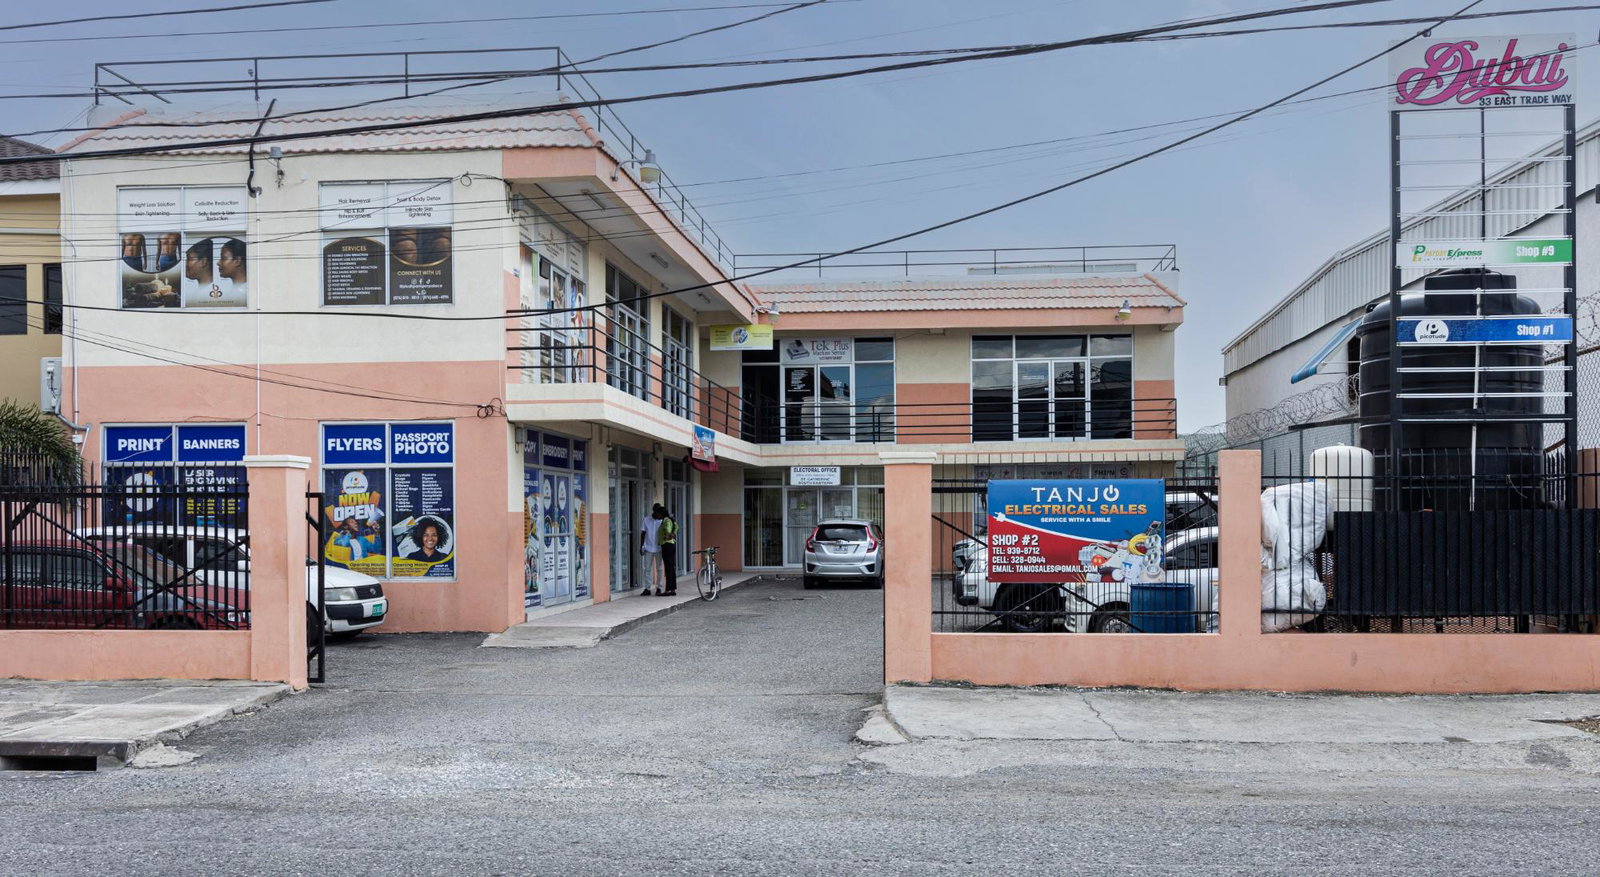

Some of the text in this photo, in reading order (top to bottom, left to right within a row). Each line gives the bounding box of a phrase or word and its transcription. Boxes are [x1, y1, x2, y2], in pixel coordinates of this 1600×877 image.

[1395, 38, 1569, 106] Dubai
[1479, 94, 1572, 106] 33 EAST TRADE WAY
[1447, 248, 1482, 258] Express
[1516, 245, 1554, 258] Shop #9
[1517, 324, 1554, 336] Shop #1
[810, 340, 849, 351] Tek Plus
[394, 432, 450, 442] PASSPORT
[118, 438, 163, 451] PRINT
[183, 439, 240, 450] BANNERS
[327, 438, 383, 451] FLYERS
[394, 441, 450, 454] PHOTO
[338, 492, 370, 506] NOW
[334, 504, 375, 522] OPEN
[1005, 504, 1148, 516] ELECTRICAL SALES
[992, 534, 1038, 546] SHOP #2
